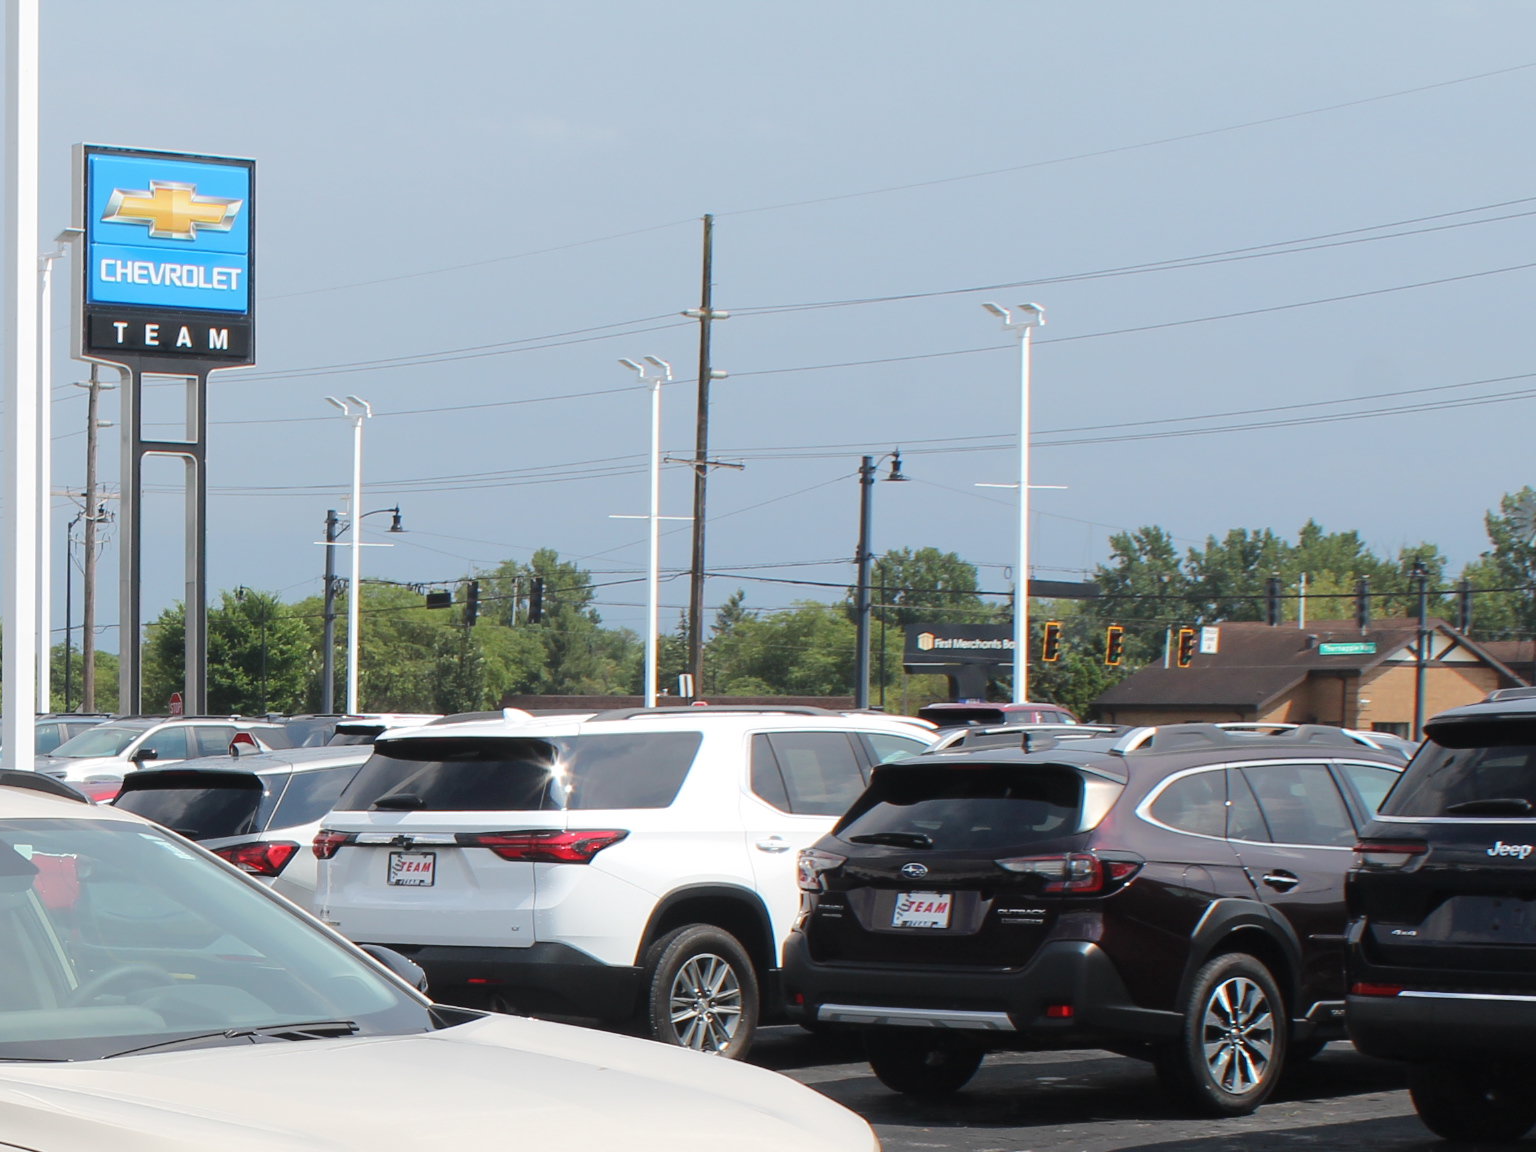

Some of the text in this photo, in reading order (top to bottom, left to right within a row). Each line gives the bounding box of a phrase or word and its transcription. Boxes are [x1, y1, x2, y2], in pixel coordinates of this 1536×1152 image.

[100, 258, 242, 291] CHEVROLET
[113, 321, 229, 351] TEAM
[934, 638, 952, 649] First
[953, 638, 1001, 650] Merchants
[1486, 840, 1533, 860] Jeep
[400, 861, 432, 872] TEAM
[908, 900, 949, 914] TEAM
